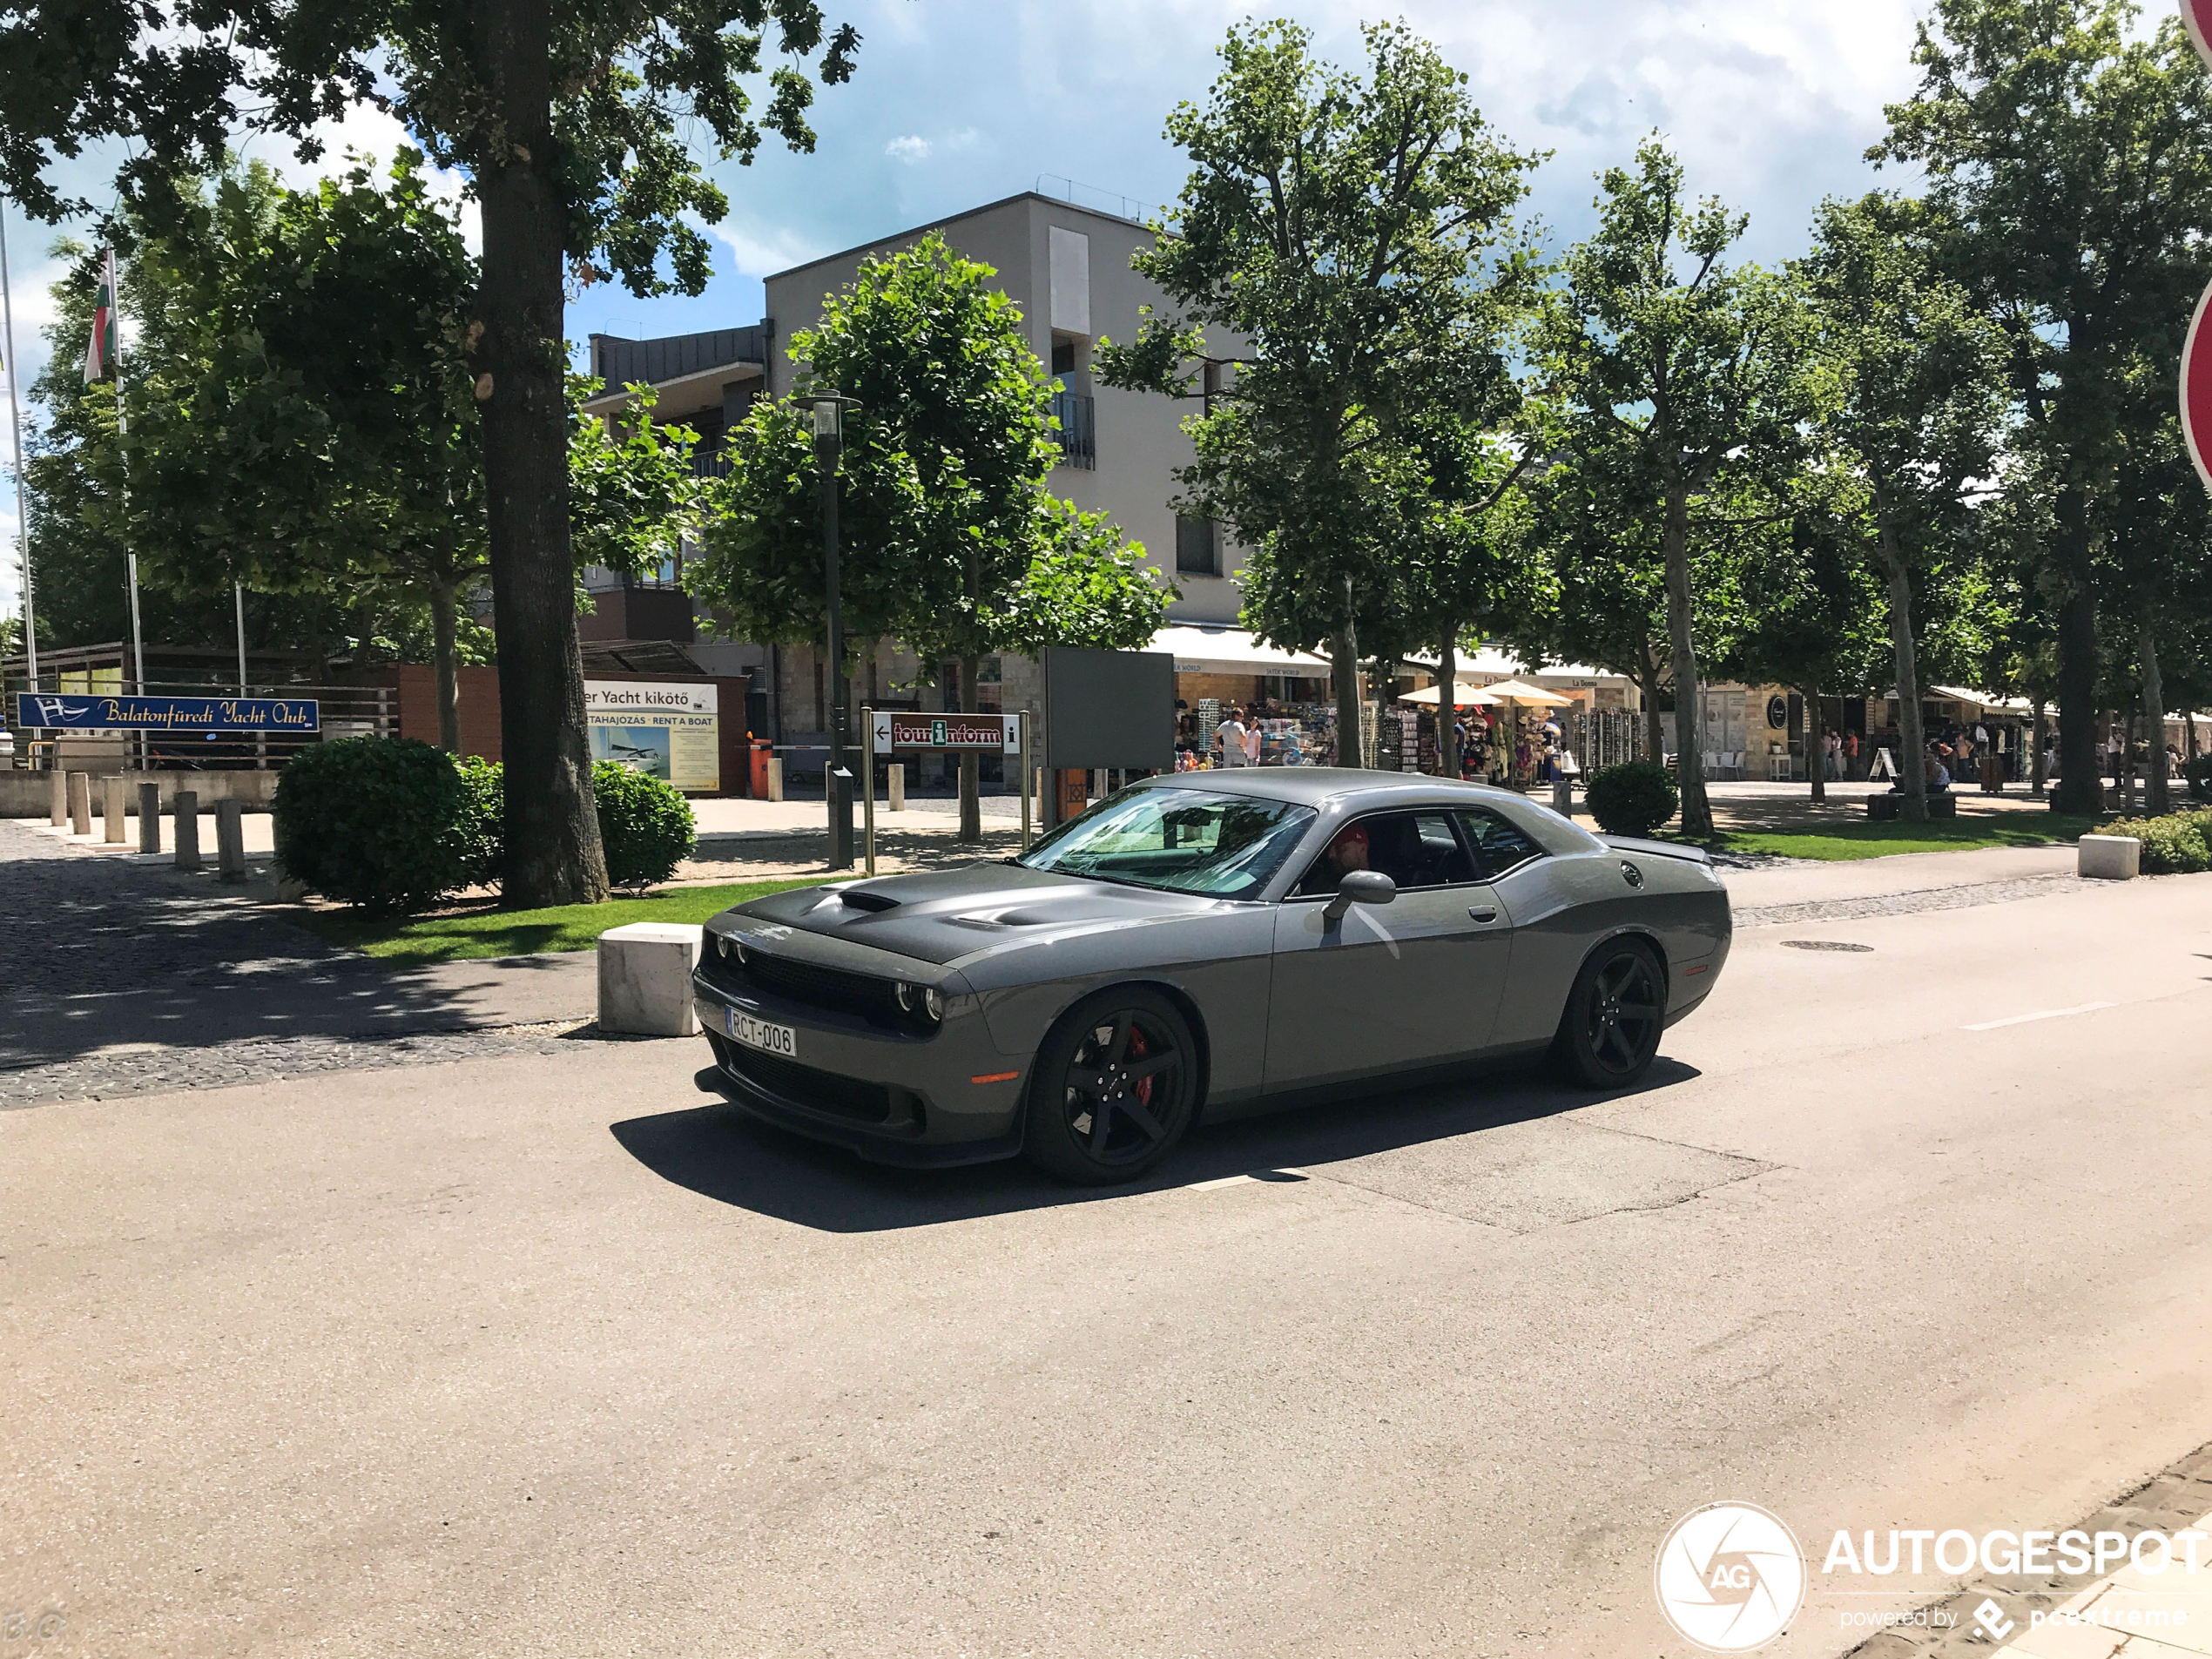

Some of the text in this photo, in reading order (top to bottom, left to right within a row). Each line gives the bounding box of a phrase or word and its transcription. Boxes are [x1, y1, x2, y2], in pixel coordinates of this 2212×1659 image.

[1485, 675, 1492, 684] La
[584, 691, 689, 705] er Yacht kikötő
[98, 699, 307, 728] Balatonfüredi Yacht Club
[652, 717, 678, 725] RENT
[688, 718, 713, 726] BOAT
[894, 722, 1001, 745] tourinform
[733, 1013, 792, 1052] RCT-006
